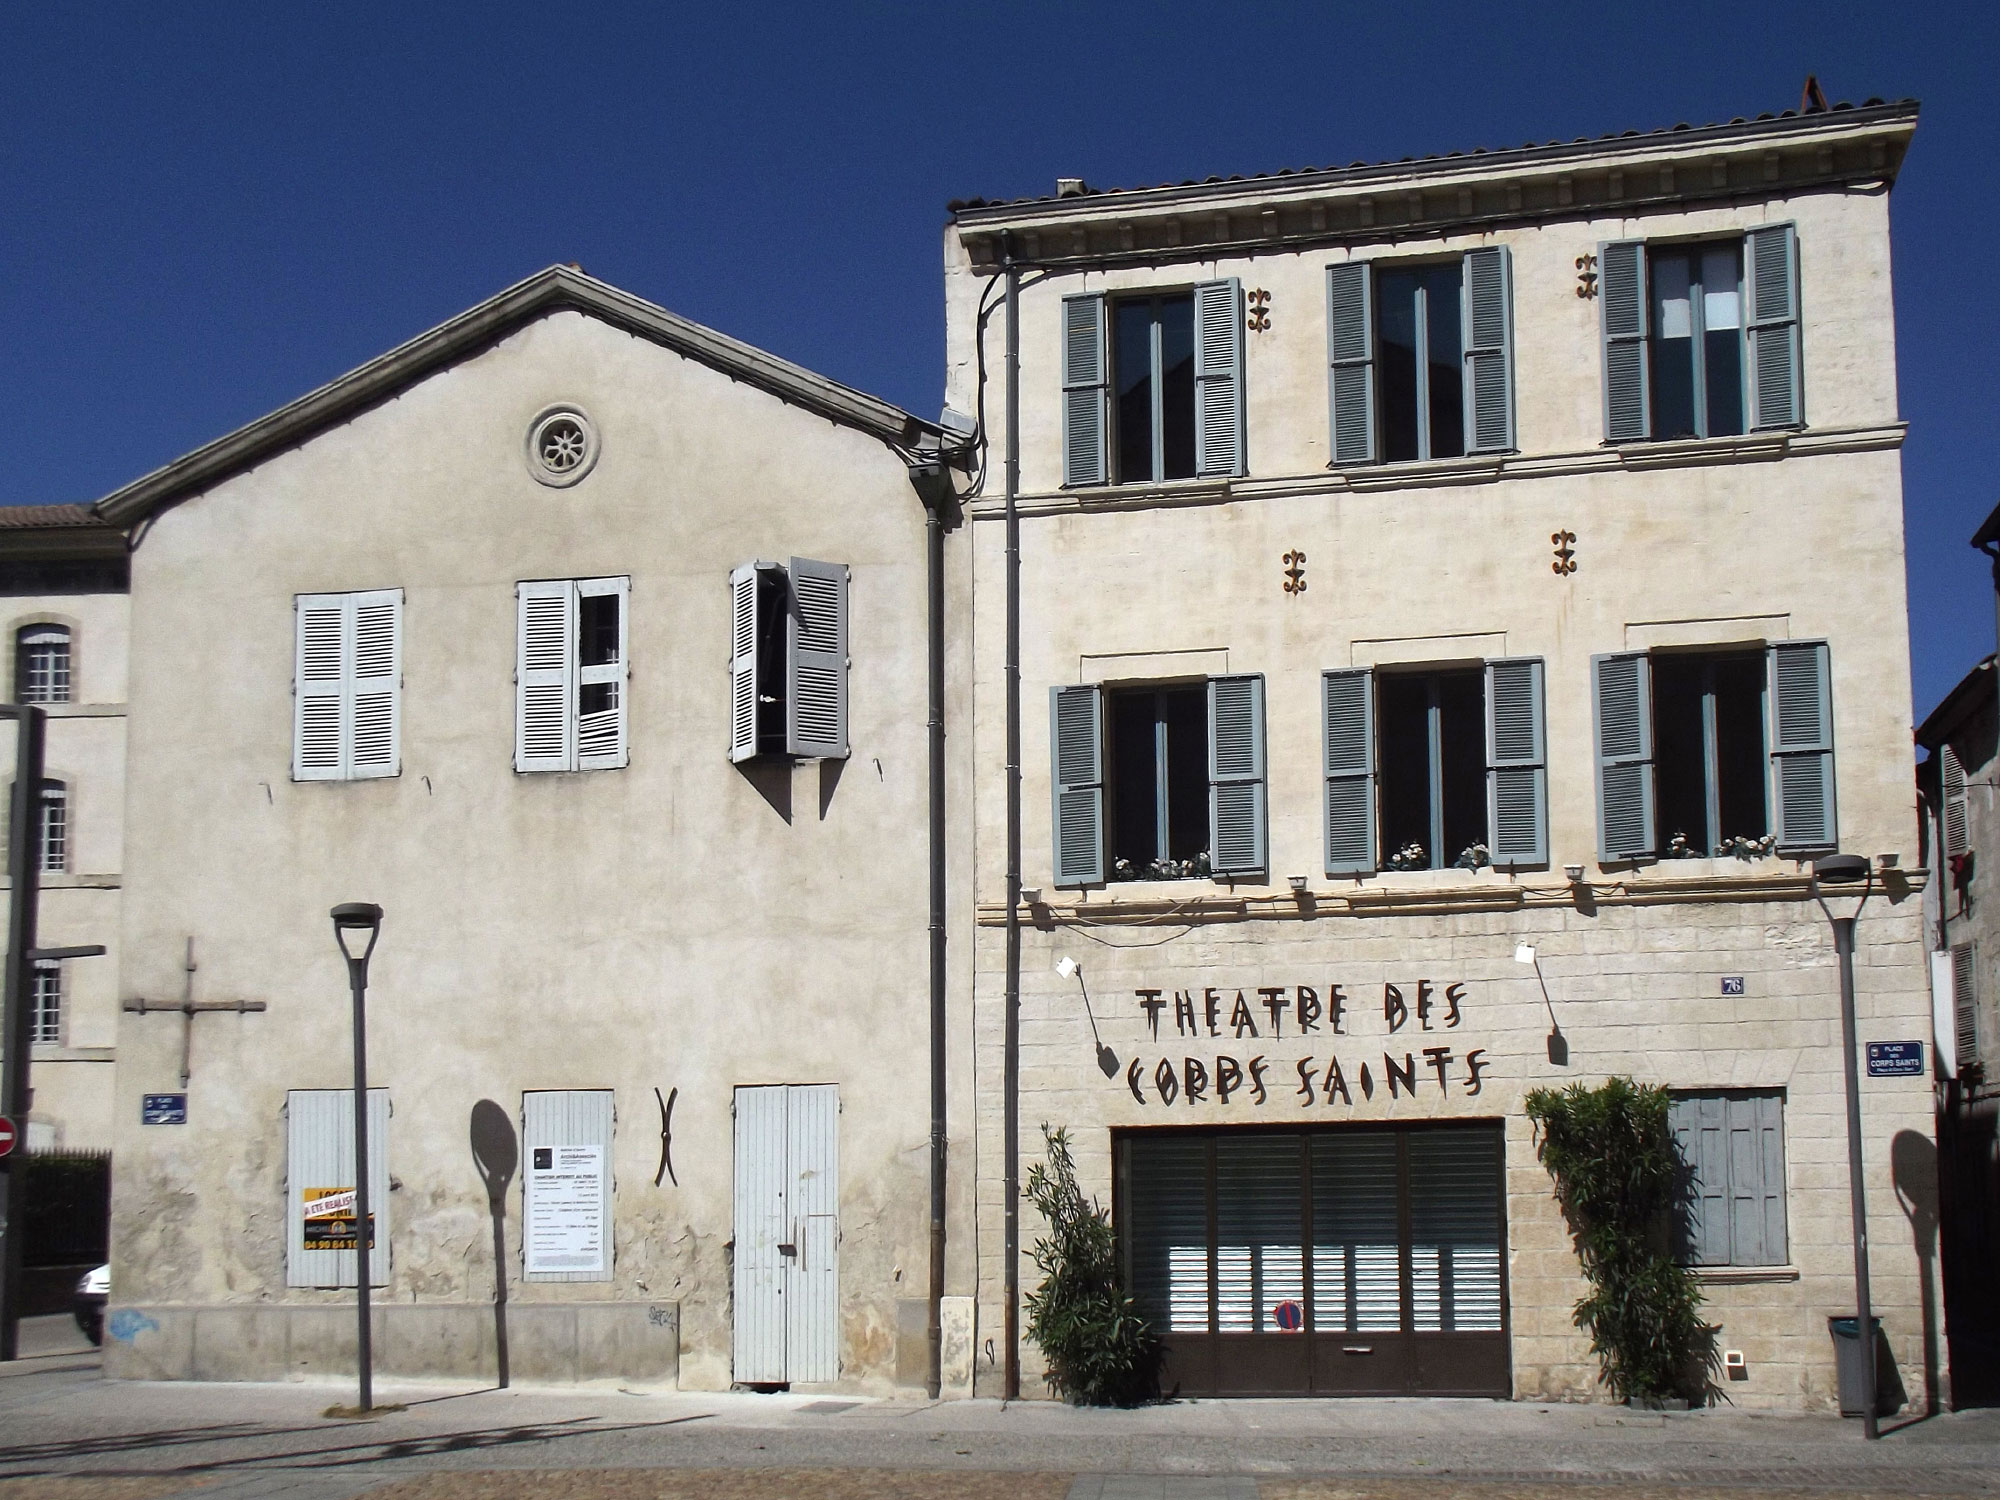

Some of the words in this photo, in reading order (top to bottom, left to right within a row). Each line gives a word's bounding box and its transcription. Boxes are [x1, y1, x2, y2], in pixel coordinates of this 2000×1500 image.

[1724, 979, 1741, 992] 76
[1135, 984, 1348, 1042] THEATRE
[1384, 979, 1467, 1034] DES
[1870, 1059, 1894, 1067] CORPS
[1895, 1058, 1920, 1067] SAINTS
[1127, 1055, 1270, 1107] CORPS
[1297, 1047, 1491, 1107] SAINTS
[304, 1240, 317, 1249] 04
[318, 1240, 331, 1249] 90
